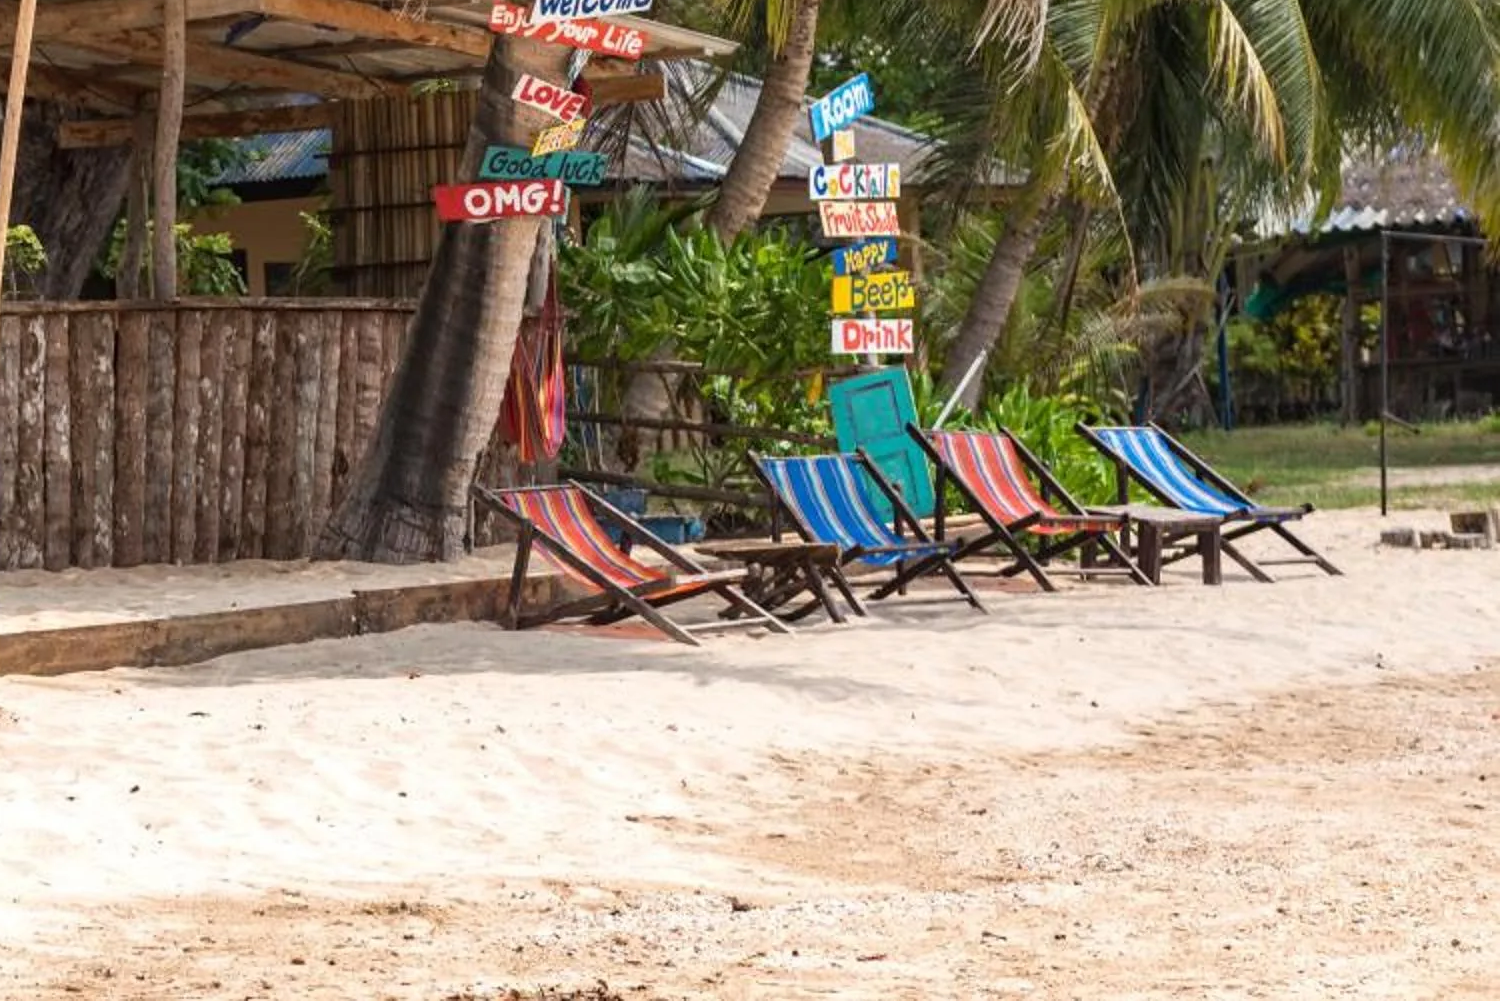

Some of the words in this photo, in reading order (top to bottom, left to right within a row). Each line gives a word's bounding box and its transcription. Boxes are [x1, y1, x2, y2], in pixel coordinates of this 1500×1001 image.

[602, 25, 644, 54] Life
[519, 77, 583, 121] LOVE
[463, 179, 563, 216] OMG!
[844, 240, 889, 274] Happy
[842, 319, 911, 351] Drink
